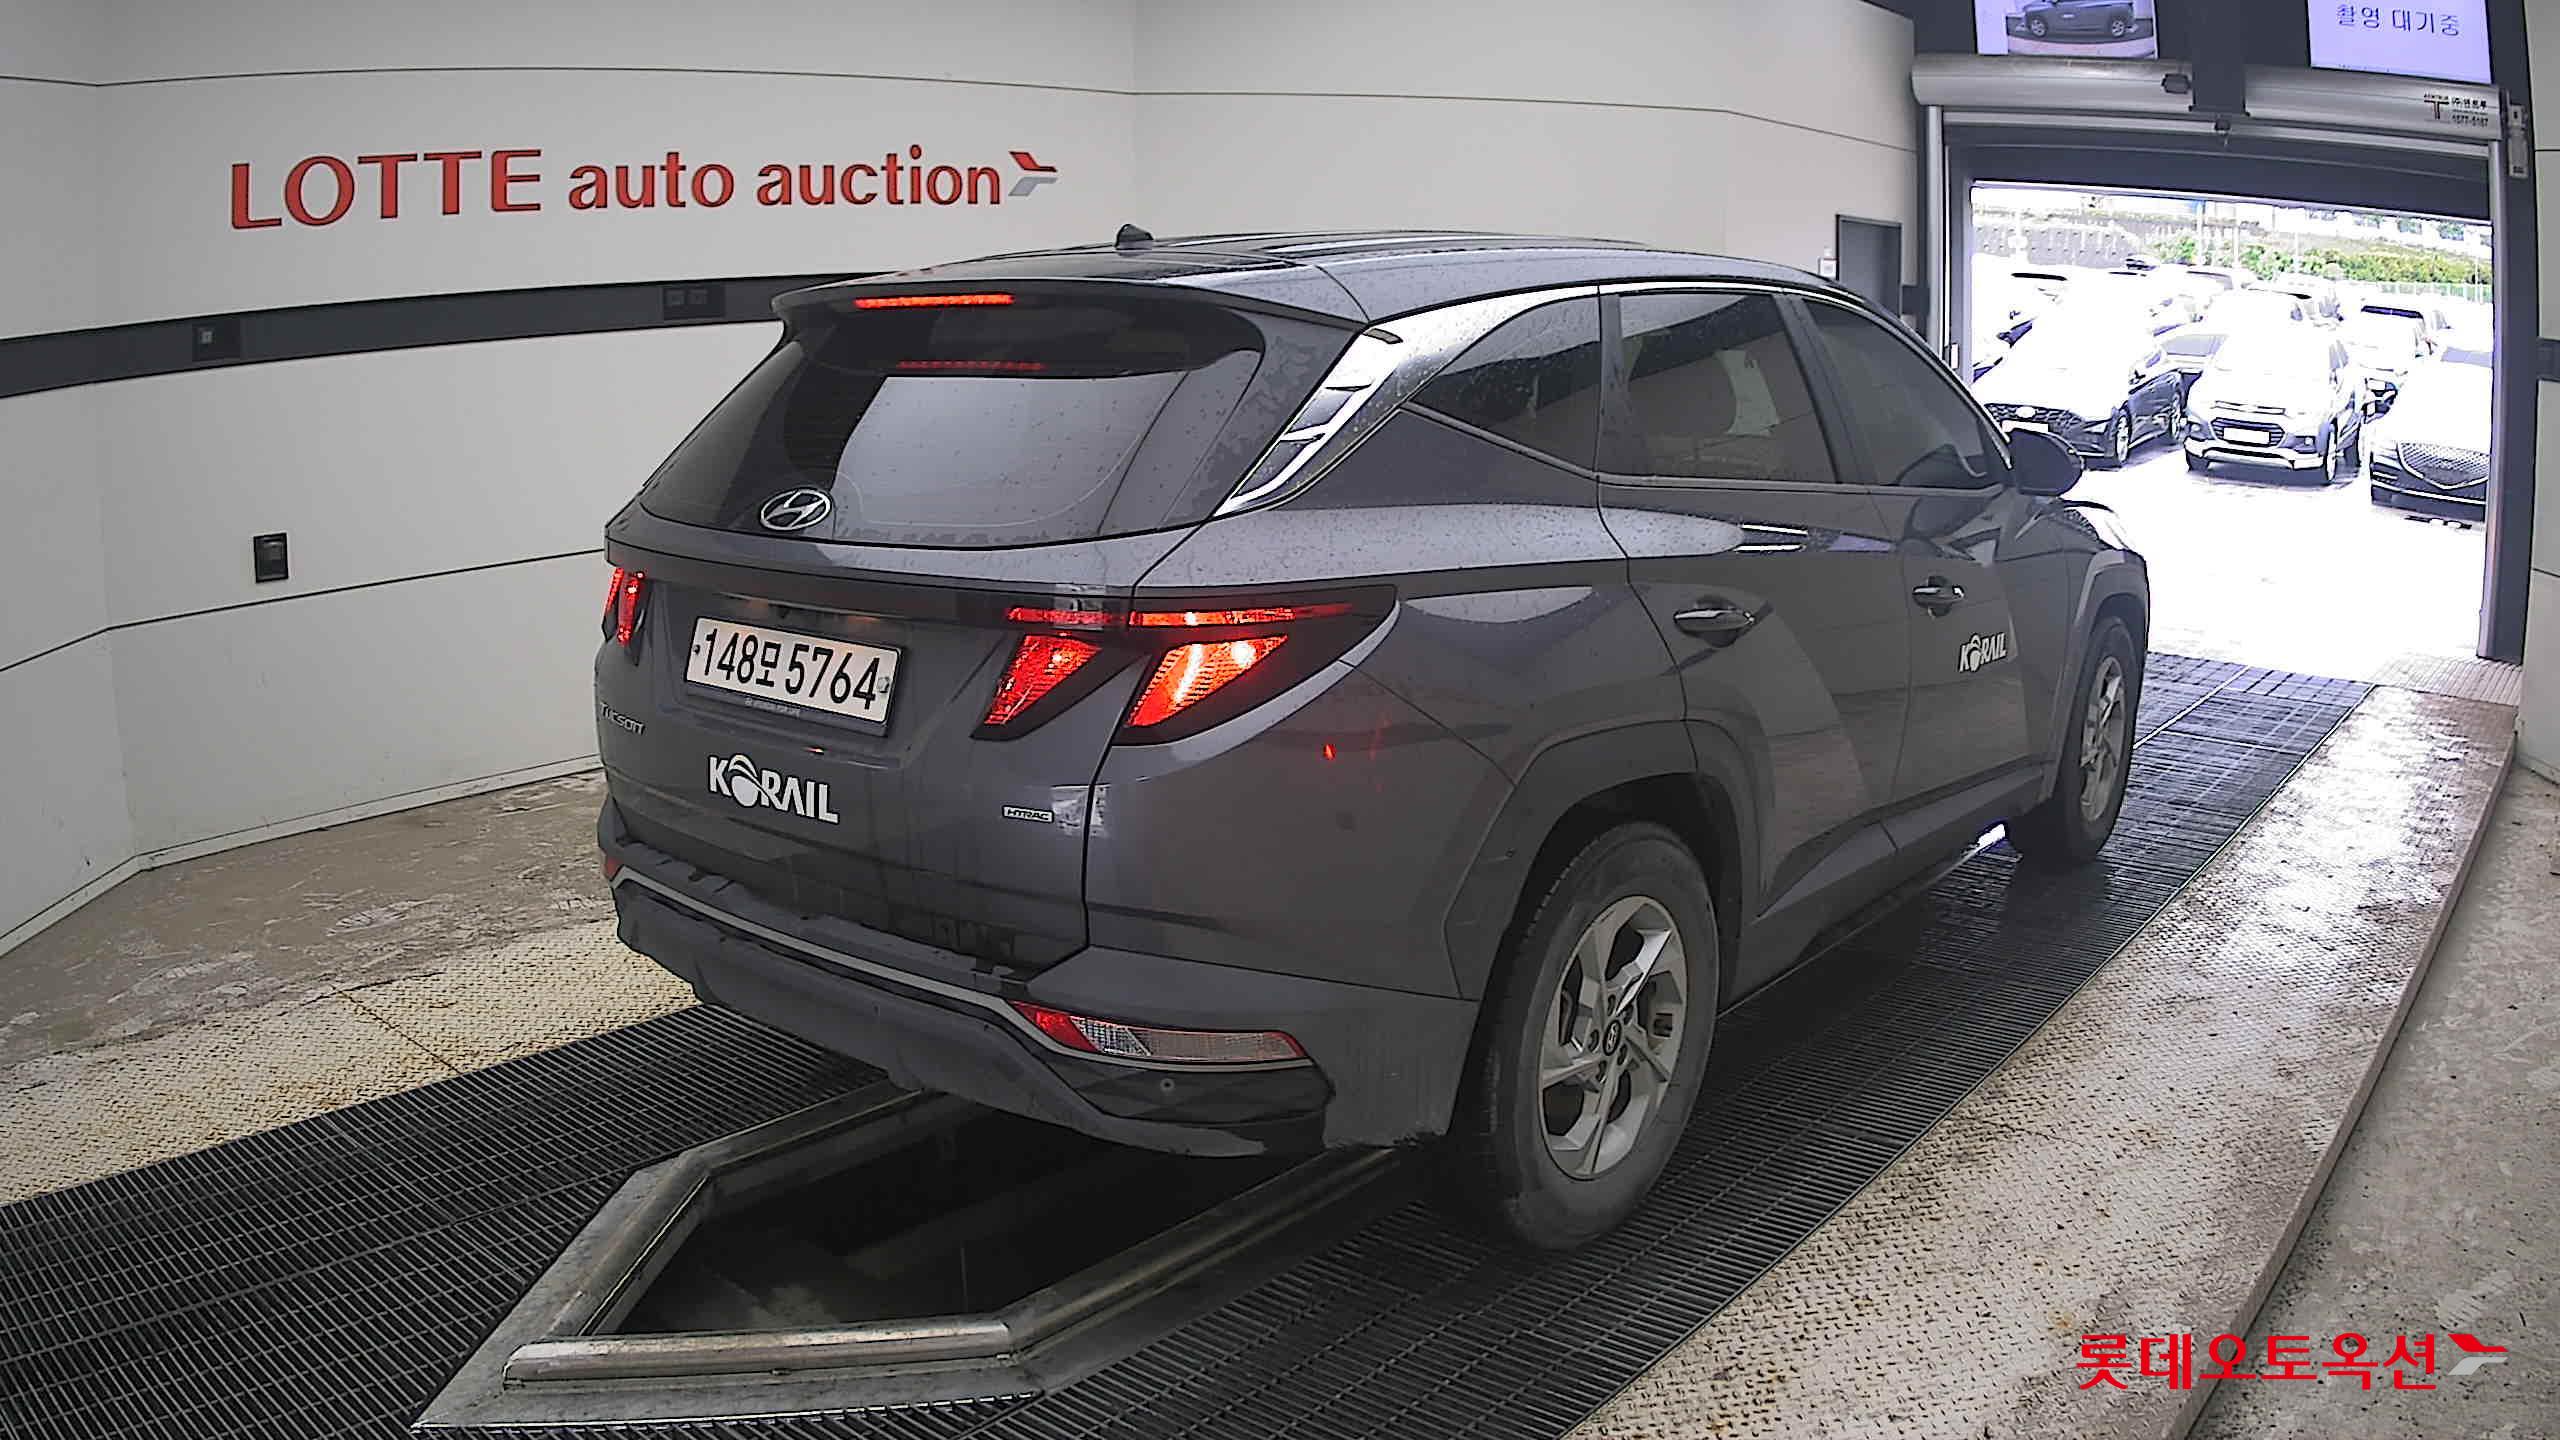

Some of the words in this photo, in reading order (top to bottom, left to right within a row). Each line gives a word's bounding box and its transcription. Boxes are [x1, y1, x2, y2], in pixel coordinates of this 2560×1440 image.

[2337, 4, 2380, 29] 촬영
[2392, 9, 2459, 36] 대기중
[231, 149, 542, 230] LOTTE
[568, 152, 735, 209] auto
[756, 144, 1000, 206] auction
[1959, 633, 2007, 672] KORAIL
[708, 754, 840, 824] KORAIL
[1005, 807, 1051, 822] HTRAC
